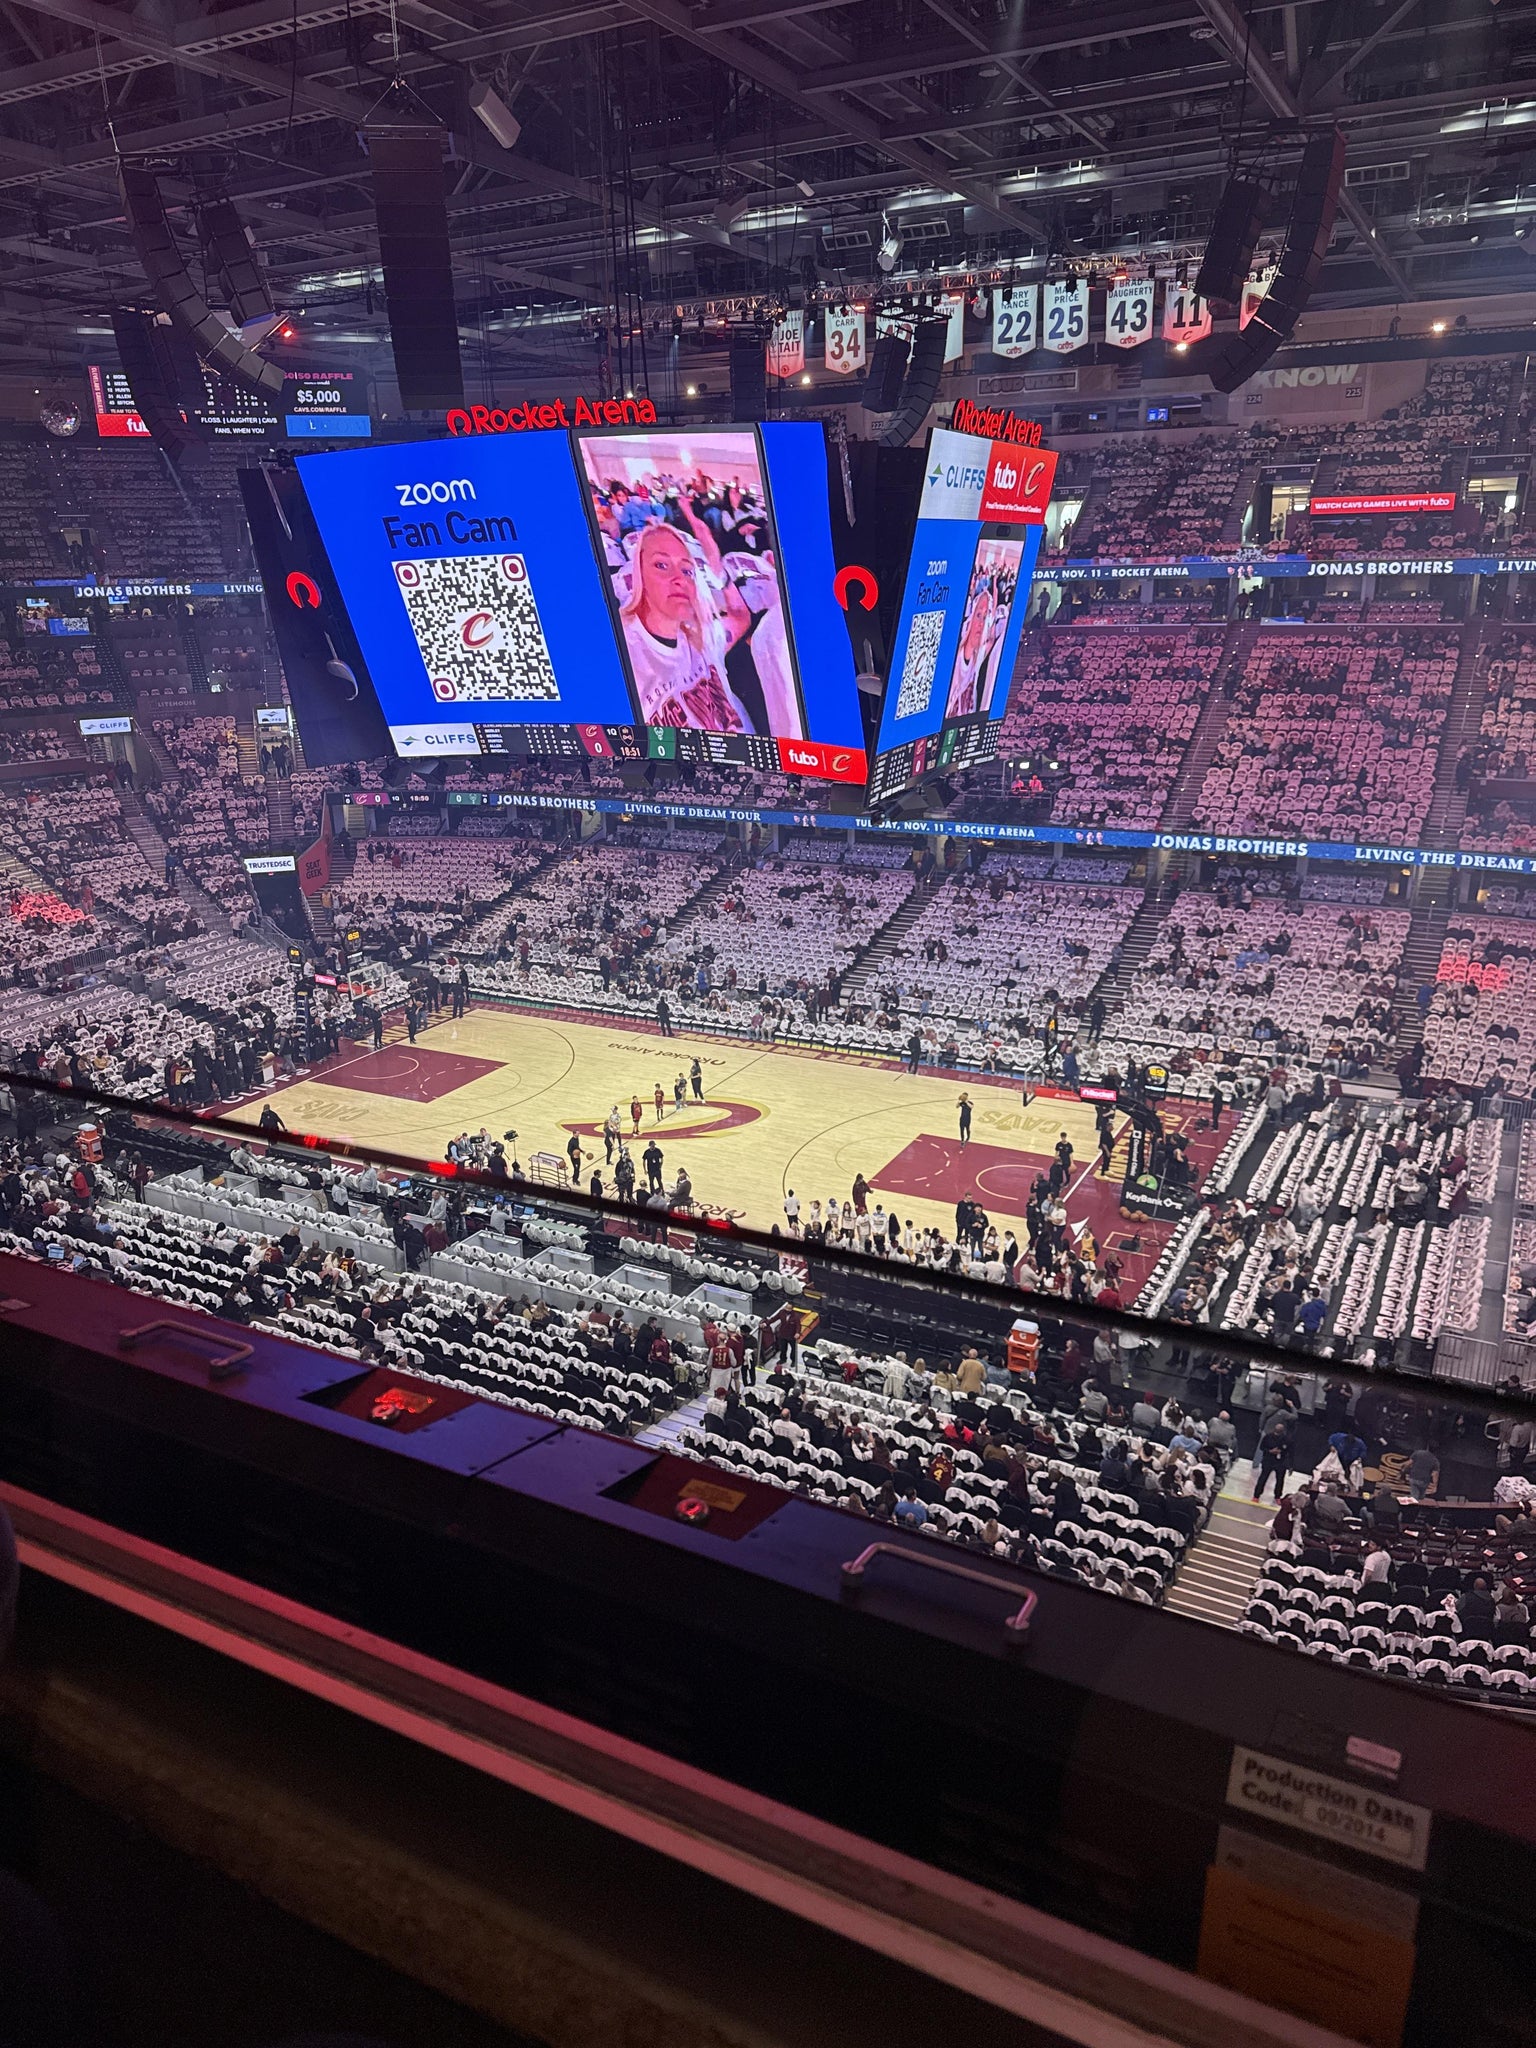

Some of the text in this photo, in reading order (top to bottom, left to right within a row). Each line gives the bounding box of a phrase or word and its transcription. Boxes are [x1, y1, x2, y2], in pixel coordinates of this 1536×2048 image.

[1119, 278, 1143, 288] BRAD
[1013, 290, 1029, 299] RRY
[1054, 294, 1079, 304] PRICE
[1108, 286, 1153, 298] DAUGHERTY
[1001, 300, 1029, 309] NANCE
[1173, 294, 1202, 328] 11
[835, 318, 855, 327] CARR
[1048, 305, 1083, 340] 25
[1111, 299, 1147, 333] 43
[780, 329, 799, 340] JOE
[998, 311, 1032, 344] 22
[779, 341, 801, 352] TAIT
[830, 328, 861, 360] 34
[297, 390, 340, 405] $5,000
[1347, 389, 1361, 397] 225
[470, 397, 657, 434] Rocket Arena
[963, 399, 1005, 438] Rocket
[1002, 411, 1043, 446] Arena
[946, 465, 985, 490] CLIFFS
[993, 461, 1017, 489] fubo
[395, 479, 476, 506] zoom
[1315, 502, 1342, 510] WATCH
[1363, 500, 1390, 508] GAMES
[1430, 497, 1449, 506] fubo
[382, 511, 518, 549] Fan Cam
[927, 560, 947, 576] zoom
[1032, 567, 1189, 579] SDAY, NOV. 11 ROCKET ARENA
[1308, 561, 1453, 576] JONAS BROTHERS
[1498, 560, 1536, 571] LIVIN
[76, 584, 191, 597] JONAS BROTHERS
[224, 584, 263, 593] LIVING
[917, 581, 950, 605] Fan Cam
[425, 734, 476, 745] CLIFFS
[594, 742, 603, 753] 0
[620, 746, 641, 756] 18:51
[657, 745, 665, 756] 0
[788, 748, 818, 766] fubo
[497, 795, 596, 810] JONAS BROTHERS
[625, 803, 761, 821] LIVING THE DREAM TOUR
[855, 819, 1035, 838] TUDAY, NOV. 11 ROCKET ARENA
[1152, 834, 1308, 856] JONAS BROTHERS
[248, 860, 292, 869] TRUSTEDSEC
[306, 860, 320, 870] SEAT
[1355, 847, 1415, 862] LIVING
[1421, 851, 1455, 865] THE
[1460, 854, 1524, 871] DREAM
[306, 868, 322, 879] GEEK
[608, 1043, 712, 1064] Rocket Arena
[222, 1068, 311, 1104] CLIFFS
[293, 1100, 369, 1121] CAVS
[978, 1111, 1062, 1133] CAVS
[1125, 1191, 1163, 1207] KeyBank
[1245, 1757, 1415, 1831] Production Date
[1316, 1806, 1387, 1842] 09/2014
